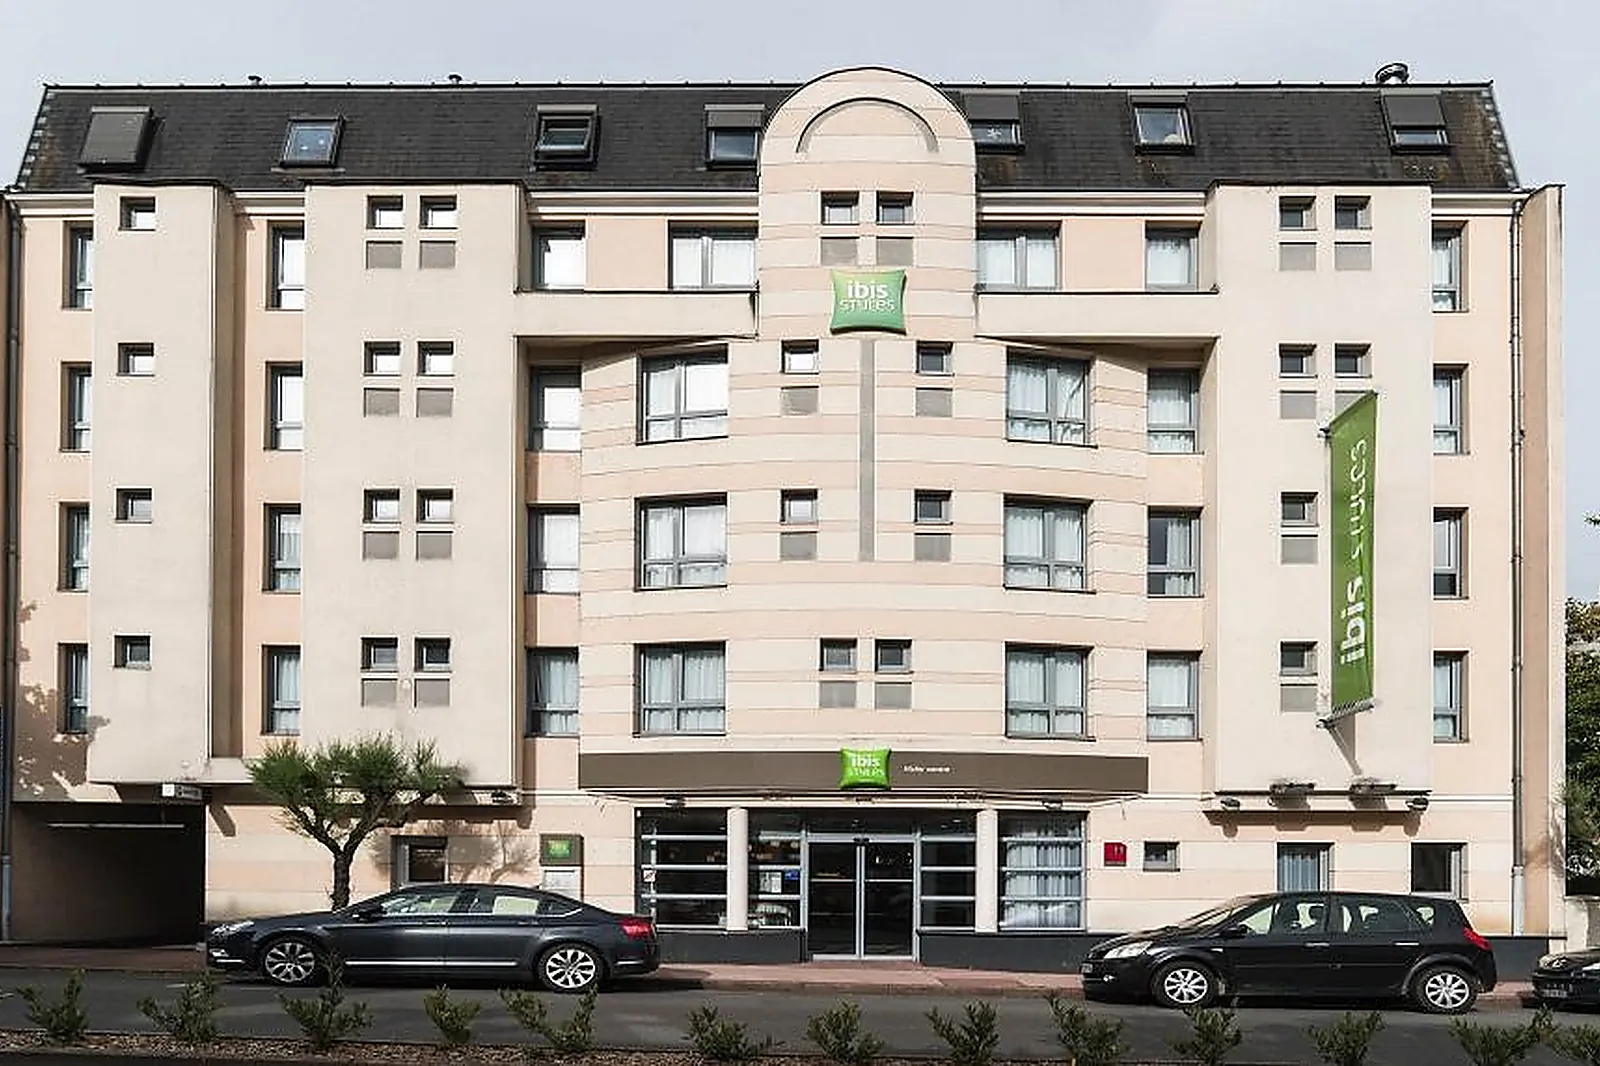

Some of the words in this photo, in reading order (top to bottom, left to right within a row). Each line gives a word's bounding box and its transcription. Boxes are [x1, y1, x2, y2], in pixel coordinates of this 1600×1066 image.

[847, 280, 889, 299] ibis
[1340, 575, 1366, 665] ibis
[851, 753, 881, 766] ibis
